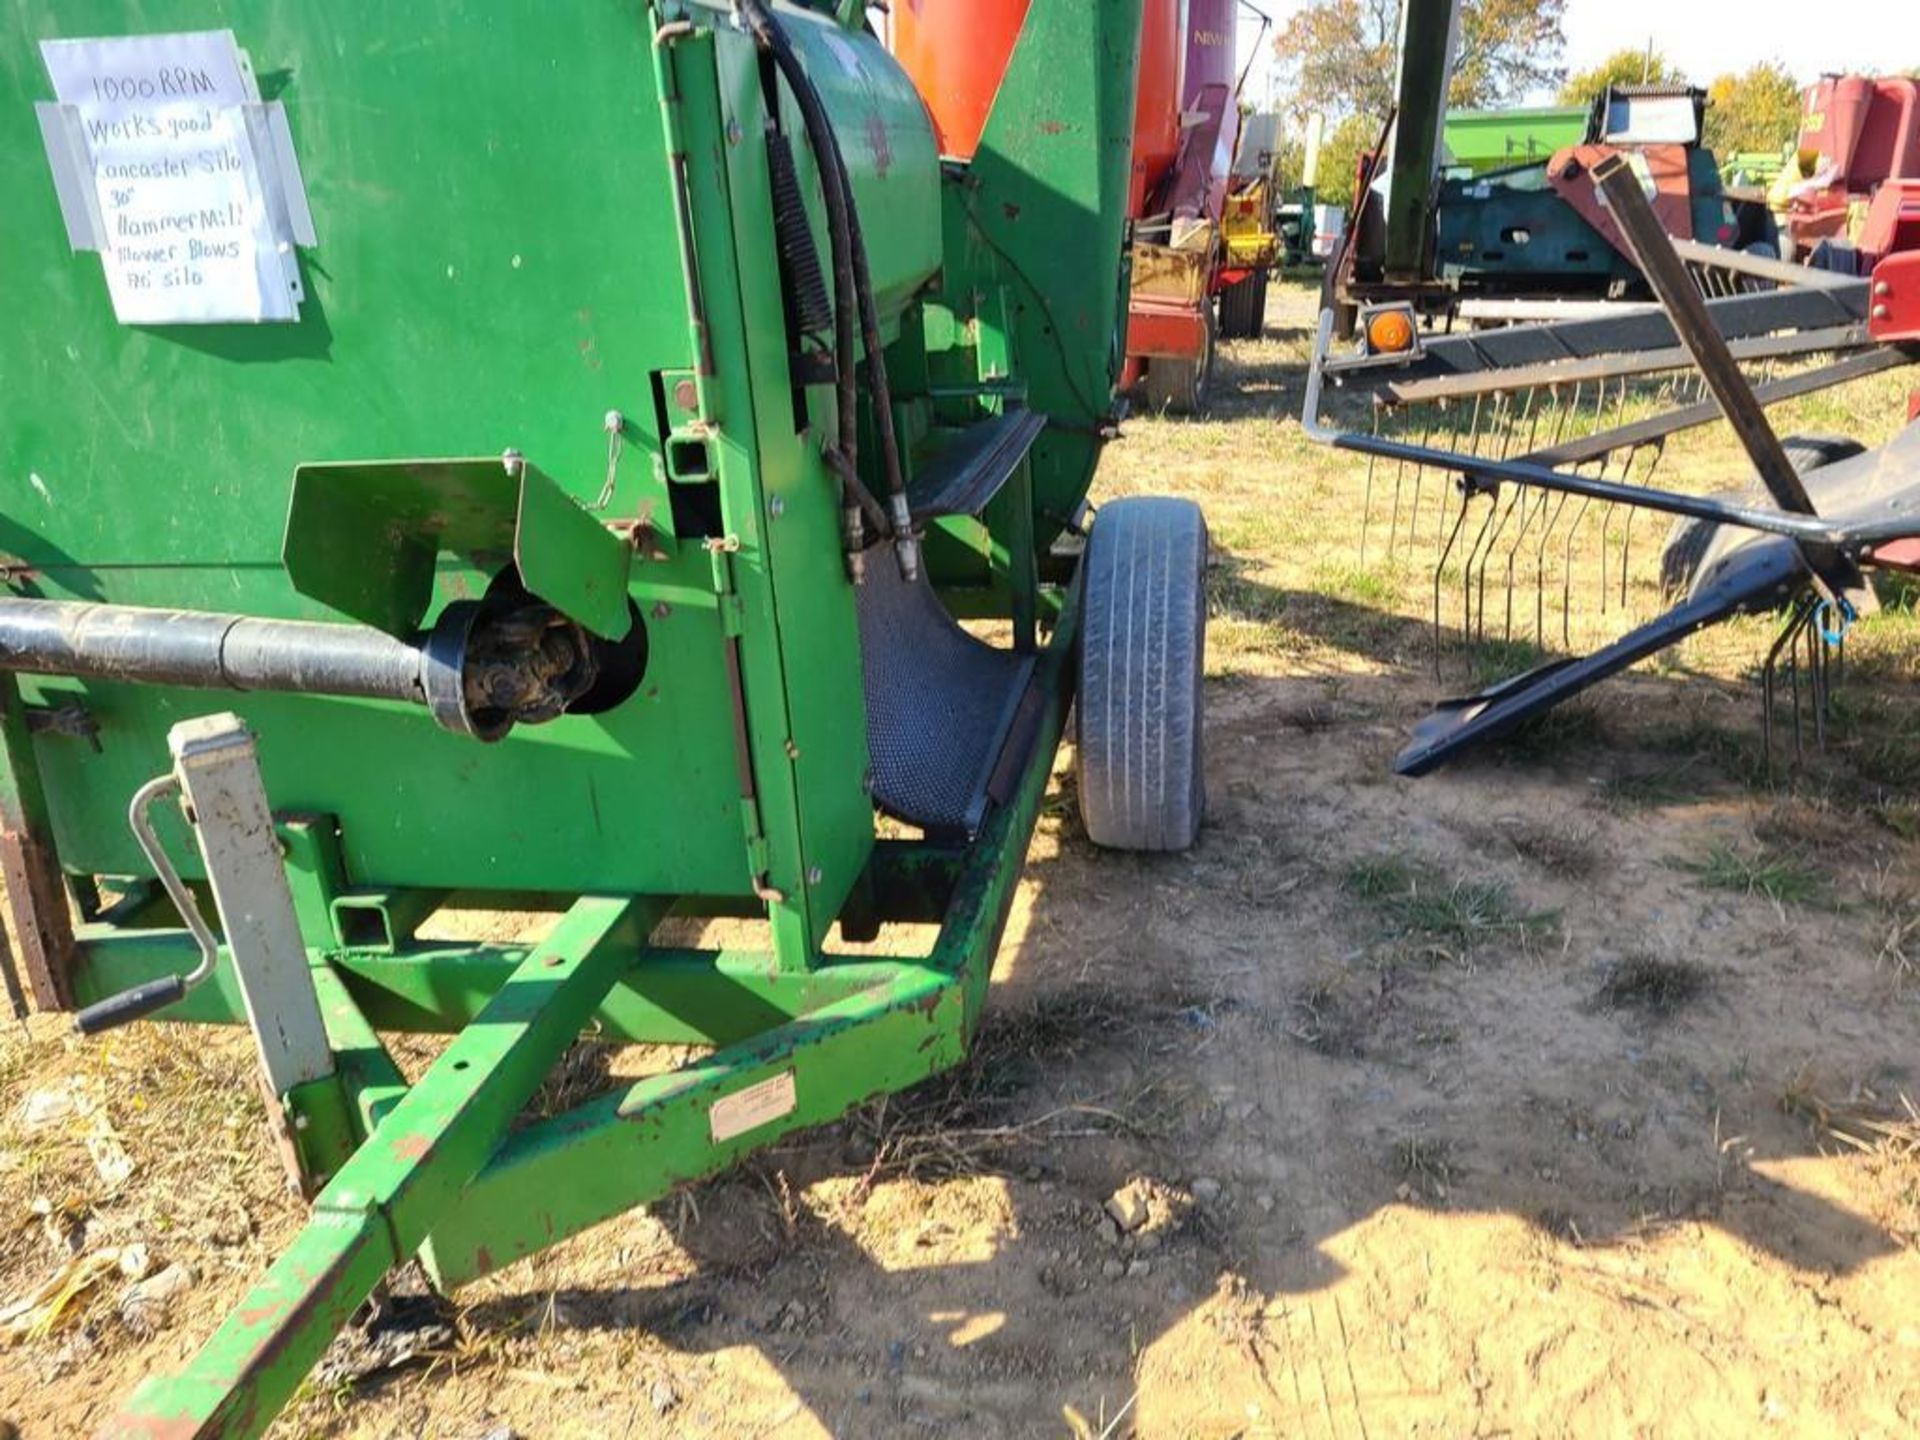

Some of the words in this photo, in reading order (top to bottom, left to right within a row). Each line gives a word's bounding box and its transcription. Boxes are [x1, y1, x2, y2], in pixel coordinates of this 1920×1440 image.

[93, 77, 155, 101] 1000
[159, 66, 217, 96] RPM
[87, 113, 163, 144] Works
[168, 108, 212, 139] good
[188, 238, 240, 260] Blows
[163, 264, 203, 288] silo
